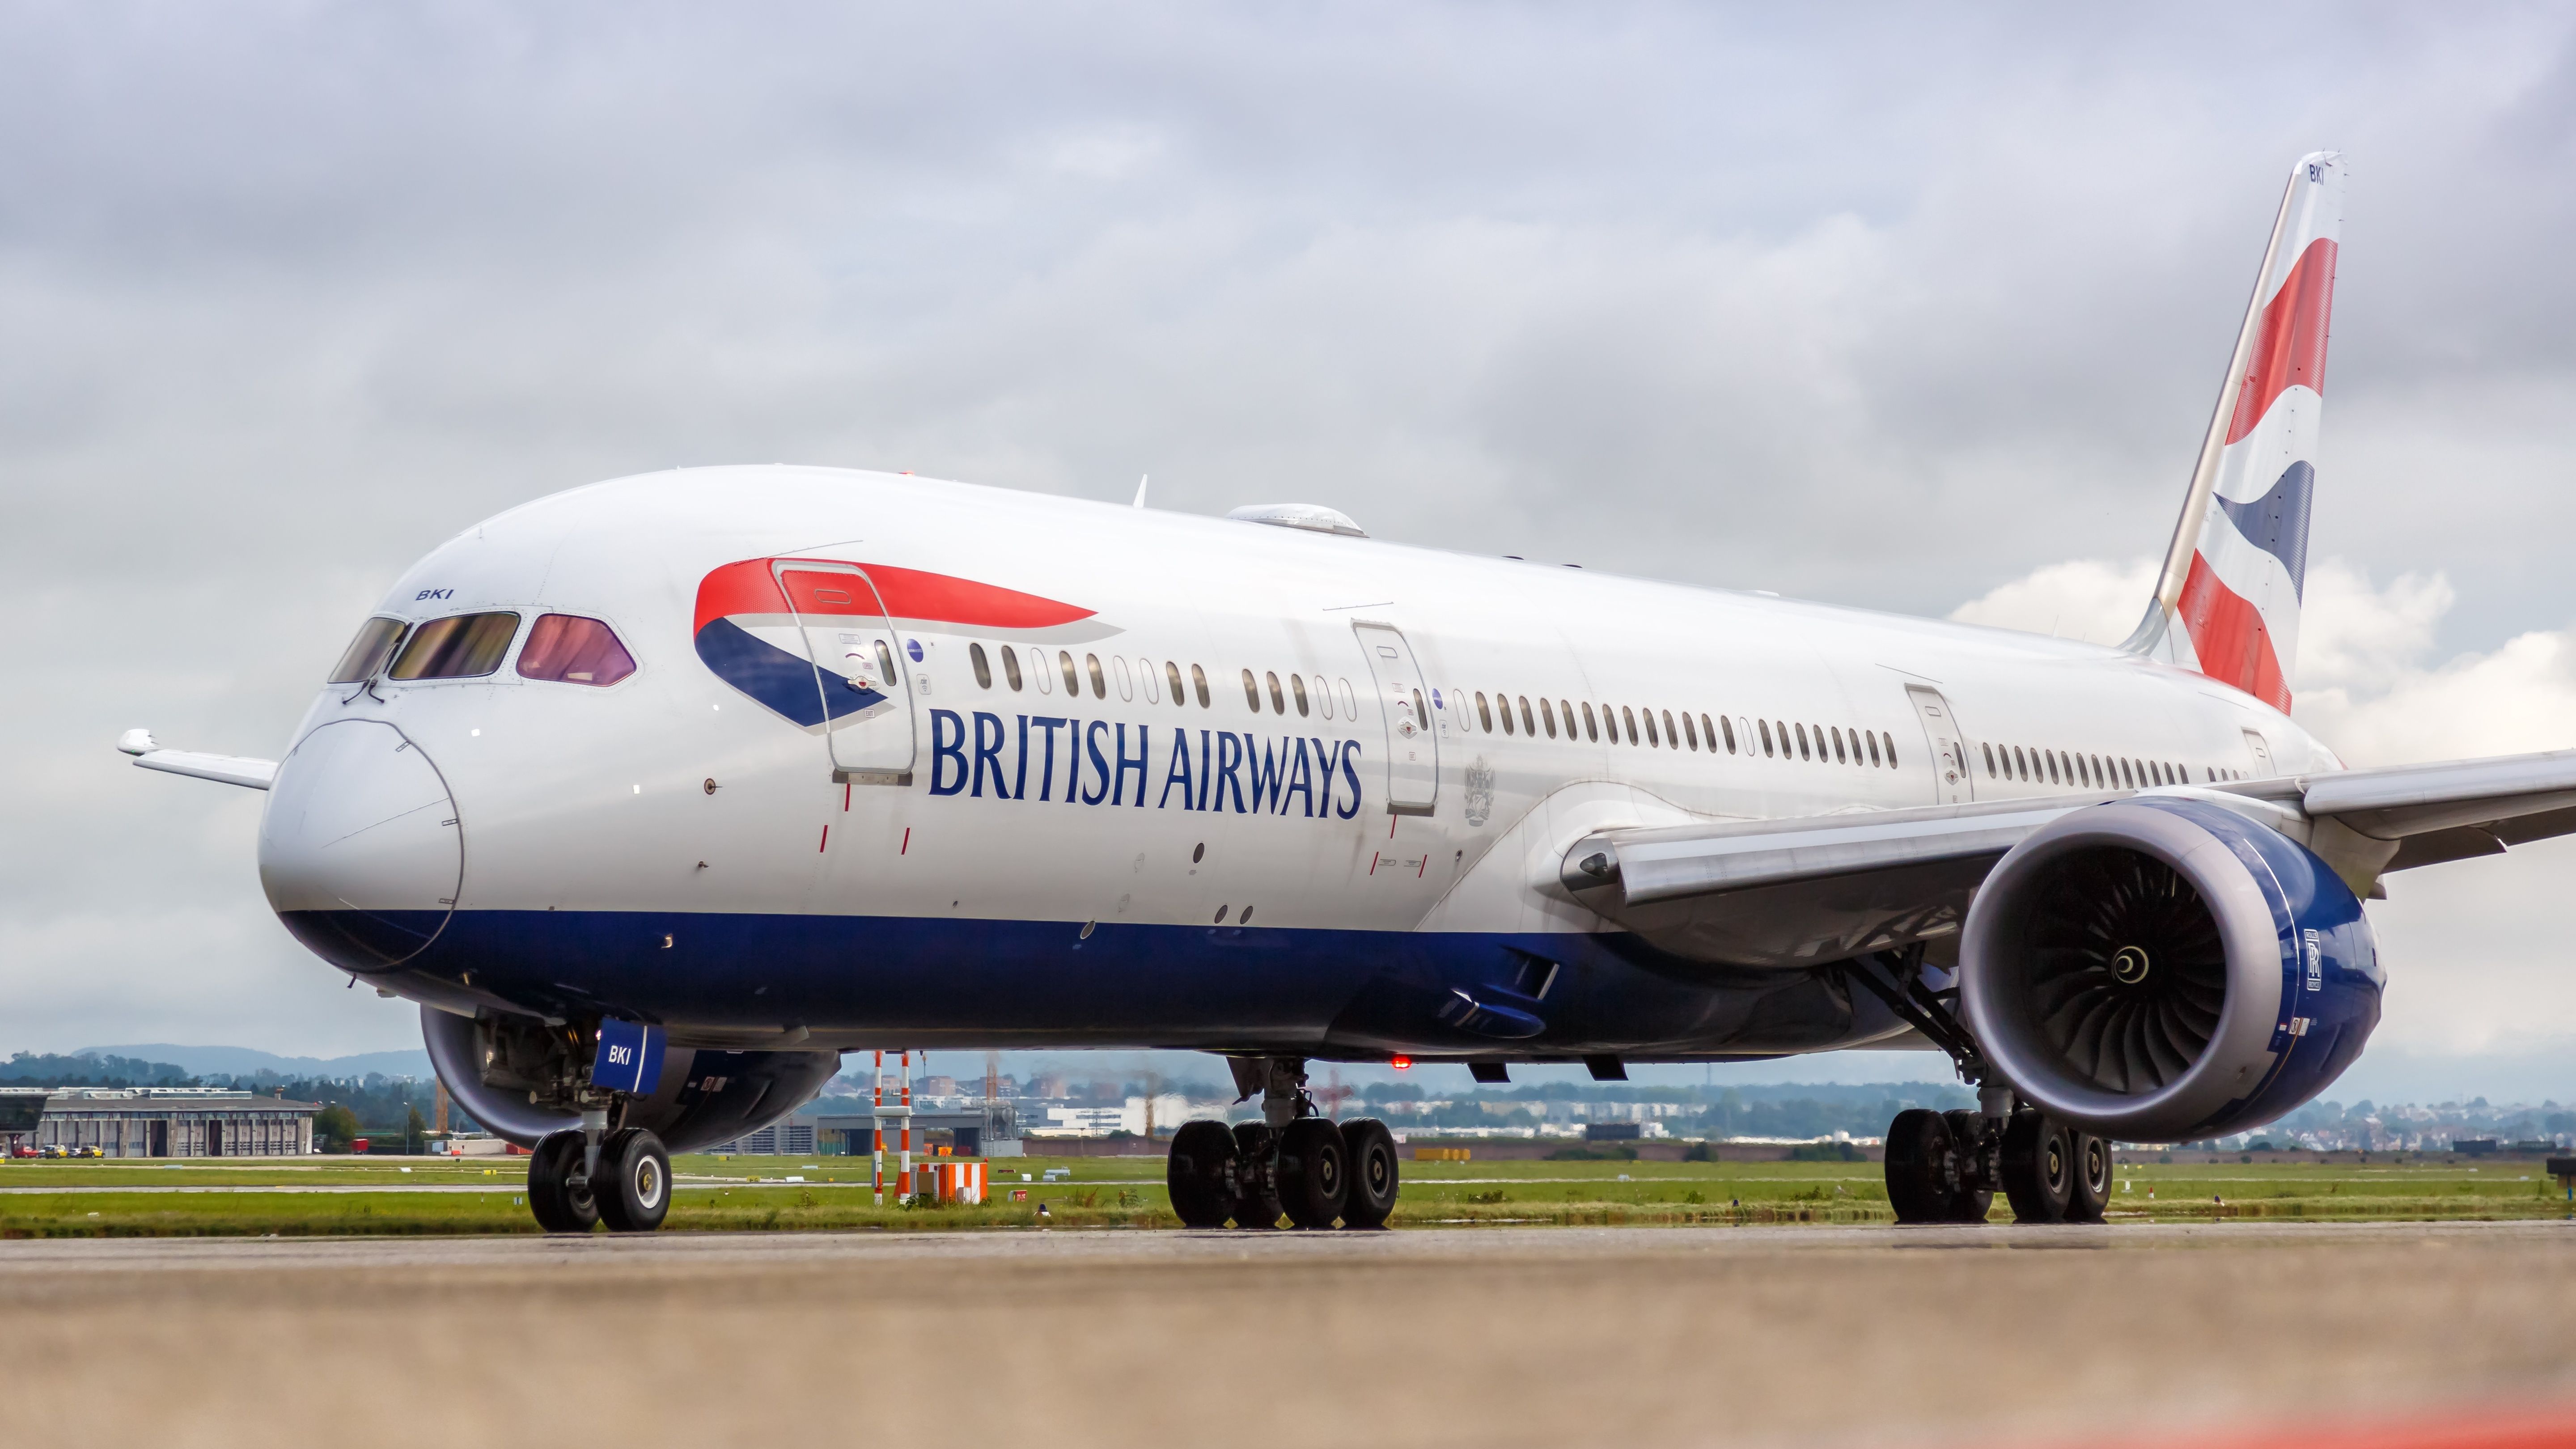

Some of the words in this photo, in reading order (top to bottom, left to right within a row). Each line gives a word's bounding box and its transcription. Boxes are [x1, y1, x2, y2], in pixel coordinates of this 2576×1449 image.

[2309, 165, 2324, 185] BKI
[415, 589, 454, 601] BKI
[928, 708, 1149, 808] BRITISH
[1157, 728, 1362, 820] AIRWAYS
[609, 1045, 631, 1065] BKI
